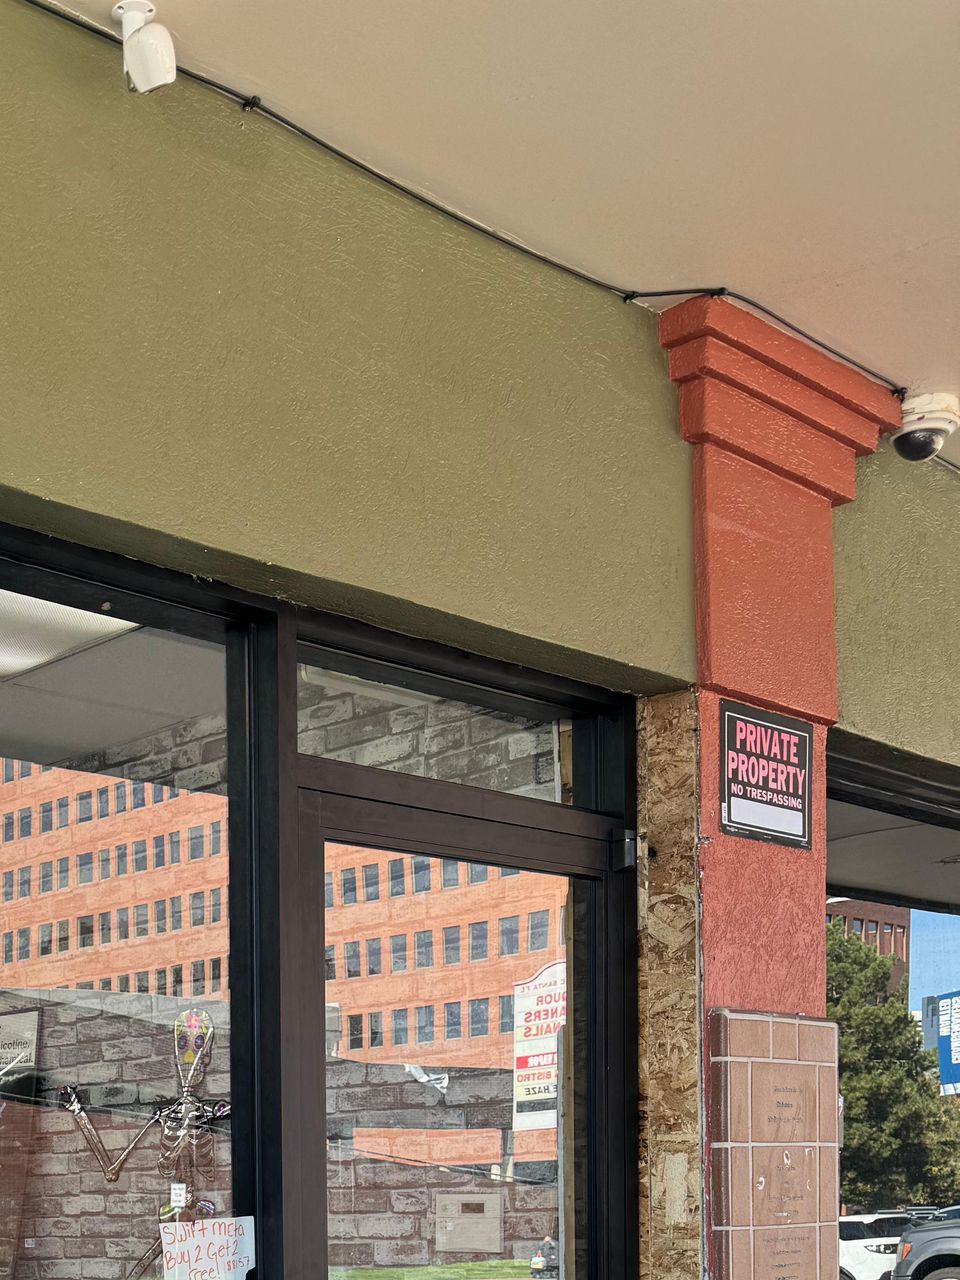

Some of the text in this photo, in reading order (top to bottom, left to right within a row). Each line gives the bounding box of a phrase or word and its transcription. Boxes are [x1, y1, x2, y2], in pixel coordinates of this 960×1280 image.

[736, 720, 799, 764] PRIVATE
[728, 750, 806, 795] PROPERTY
[731, 783, 803, 809] NO TRESPASSING
[164, 1239, 239, 1271] Buy 2 Get 2
